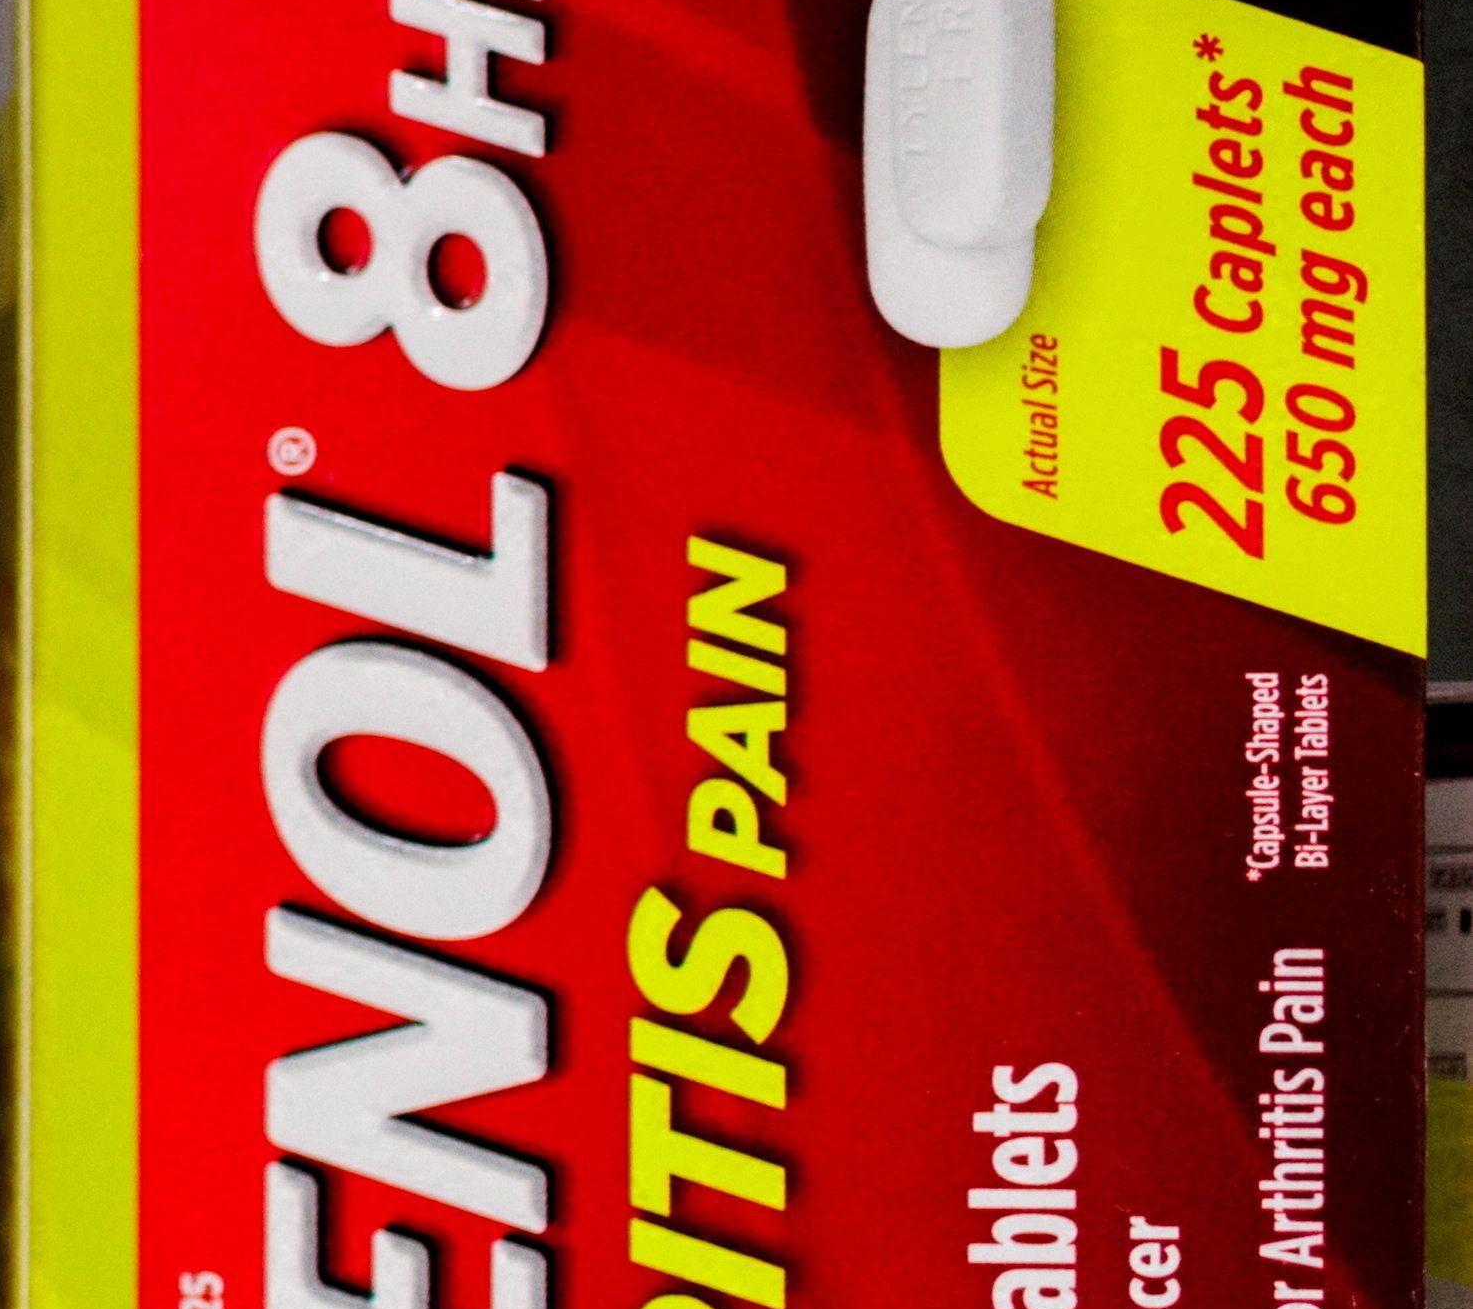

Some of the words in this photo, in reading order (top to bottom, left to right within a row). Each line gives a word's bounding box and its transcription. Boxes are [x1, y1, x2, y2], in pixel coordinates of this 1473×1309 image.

[1283, 66, 1355, 231] each
[1022, 333, 1058, 394] Size
[1300, 249, 1368, 369] mg
[1022, 399, 1058, 499] Actual
[1159, 346, 1264, 559] 225
[1285, 384, 1356, 524] 650
[687, 537, 786, 878] PAIN
[1294, 674, 1328, 760] Tablets
[1295, 766, 1333, 867] Bi-Layer
[1259, 949, 1324, 1052] Pain
[1259, 1068, 1324, 1268] Arthritis
